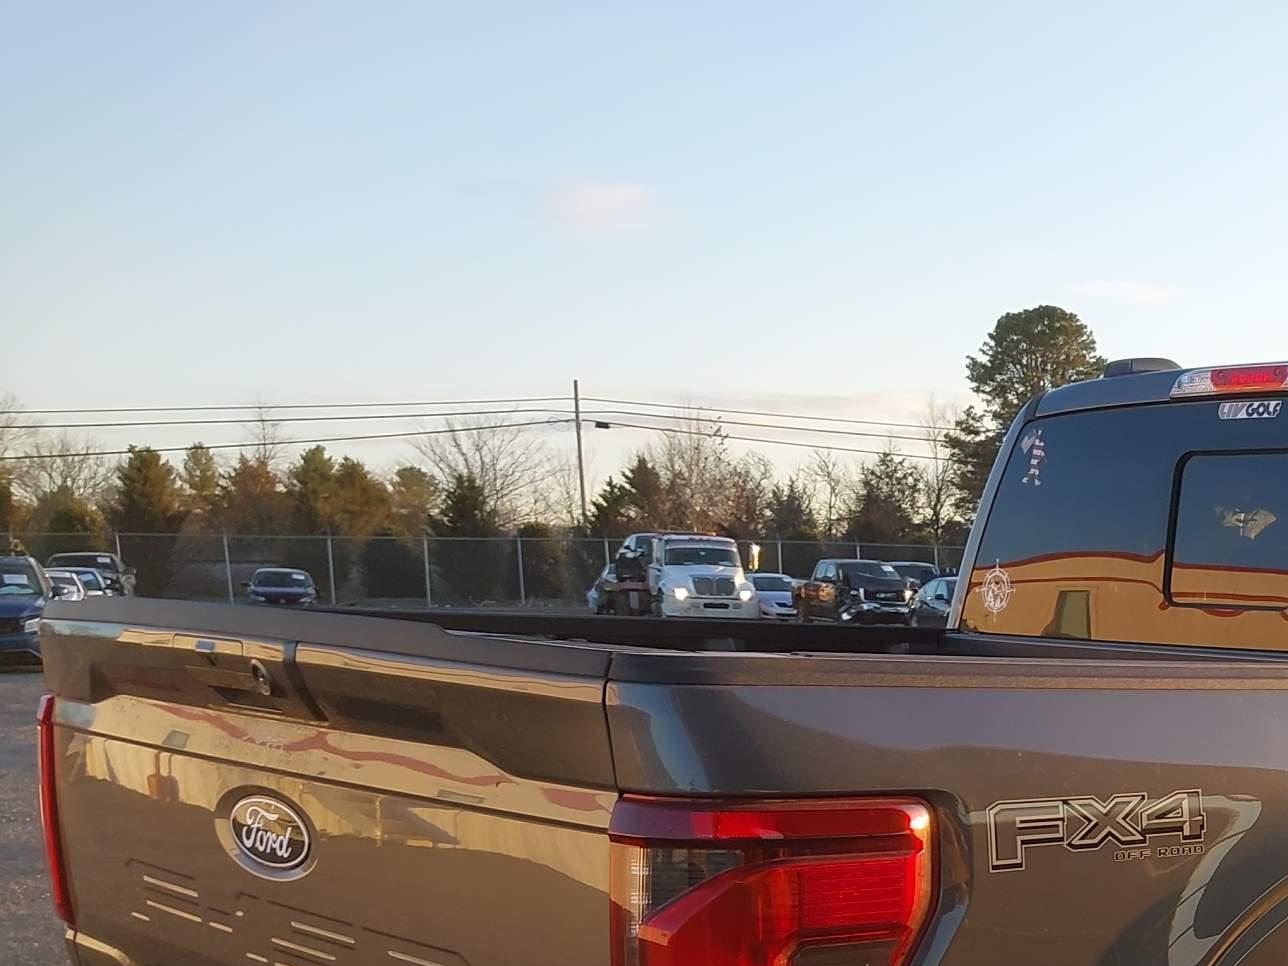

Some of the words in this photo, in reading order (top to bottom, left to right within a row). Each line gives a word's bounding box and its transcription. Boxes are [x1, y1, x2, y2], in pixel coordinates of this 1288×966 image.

[1245, 402, 1281, 417] GOLF
[242, 806, 292, 858] Ford
[986, 789, 1206, 872] FX4
[1114, 849, 1151, 862] OFF
[1157, 844, 1205, 858] ROAD
